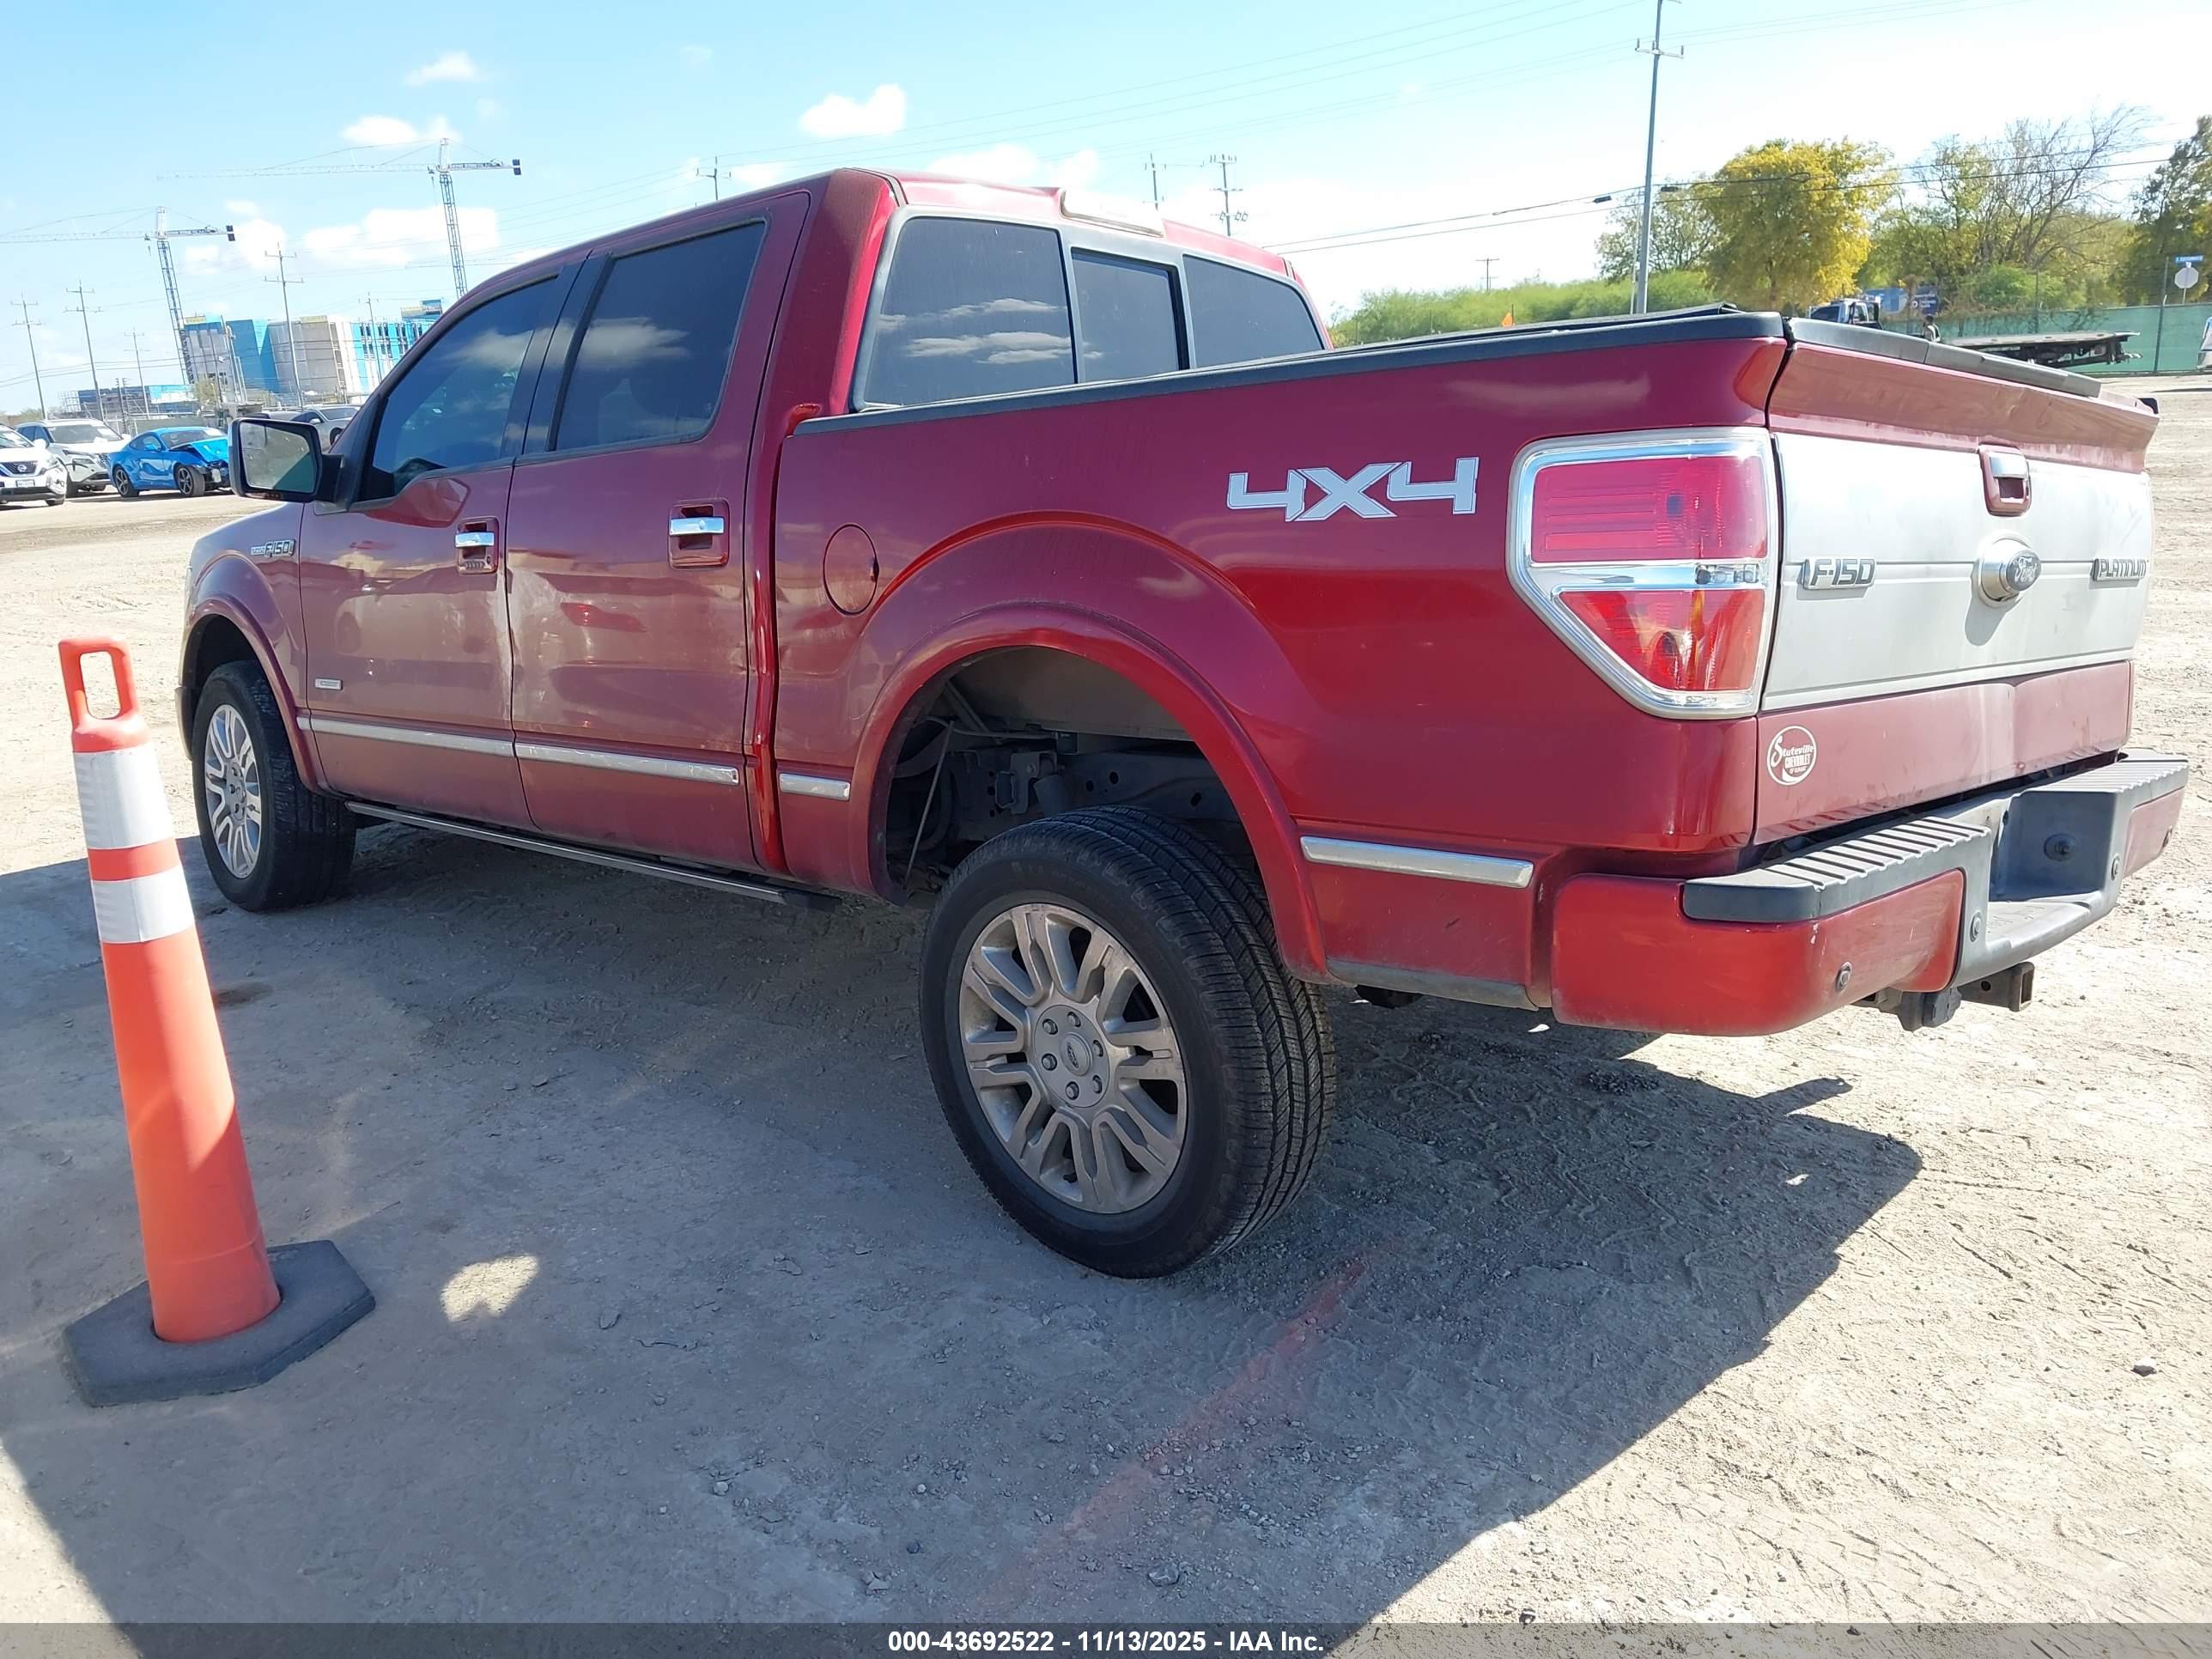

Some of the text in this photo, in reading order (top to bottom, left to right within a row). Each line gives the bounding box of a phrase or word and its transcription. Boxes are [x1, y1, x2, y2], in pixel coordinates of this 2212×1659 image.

[1809, 559, 1875, 586] F-150
[2014, 556, 2038, 583] Ford
[2099, 558, 2147, 578] PLATINUM
